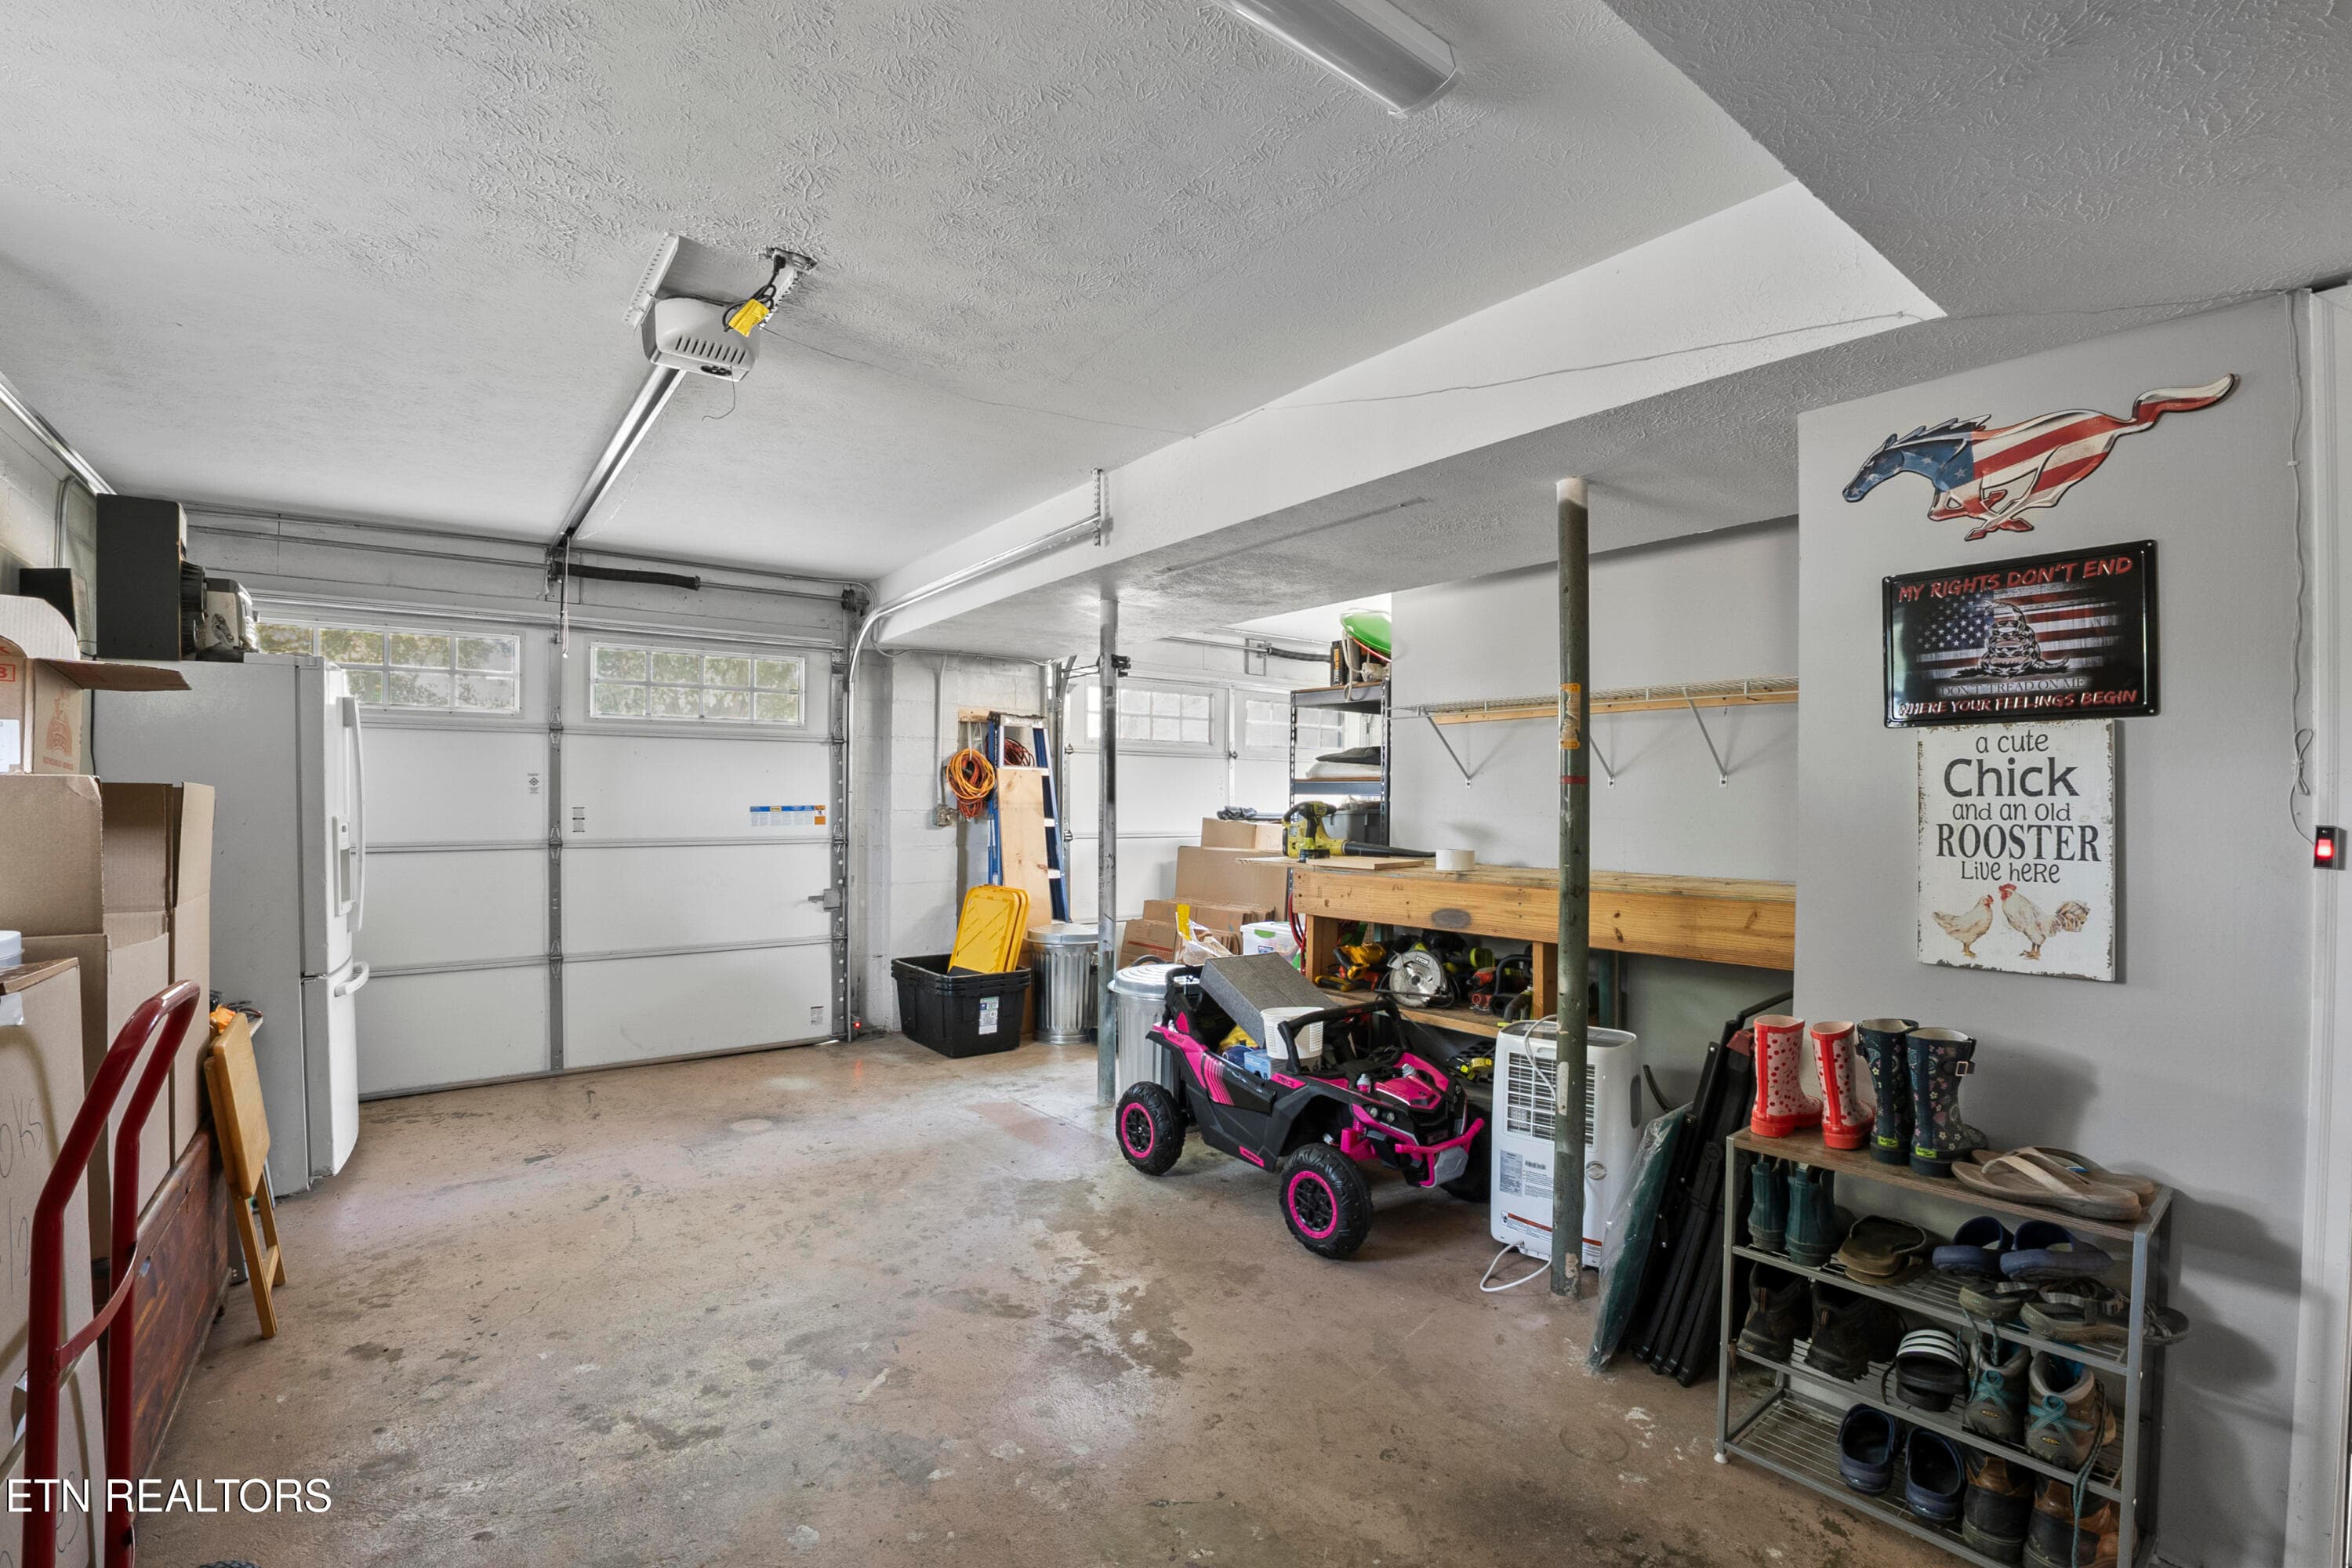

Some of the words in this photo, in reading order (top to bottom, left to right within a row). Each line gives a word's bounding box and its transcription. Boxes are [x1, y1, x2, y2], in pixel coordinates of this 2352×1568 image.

[1899, 584, 1925, 603] MY
[1930, 573, 2001, 599] RIGHTS
[2007, 562, 2078, 588] DON'T
[2082, 556, 2132, 579] END
[1940, 684, 1983, 697] DON'T
[1989, 681, 2034, 693] TREAD
[2038, 680, 2058, 691] ON
[2063, 677, 2086, 689] ME
[1899, 702, 1947, 715] WHERE
[1951, 699, 1993, 713] YOUR
[1995, 693, 2076, 711] FEELINGS
[2081, 689, 2138, 705] BEGIN
[1976, 736, 1988, 753] a
[1997, 729, 2049, 753] cute
[1944, 757, 2080, 798] Chick
[1952, 802, 1993, 821] and
[1999, 803, 2027, 821] an
[1936, 823, 2102, 862] ROOSTER
[1961, 861, 2002, 881] Live
